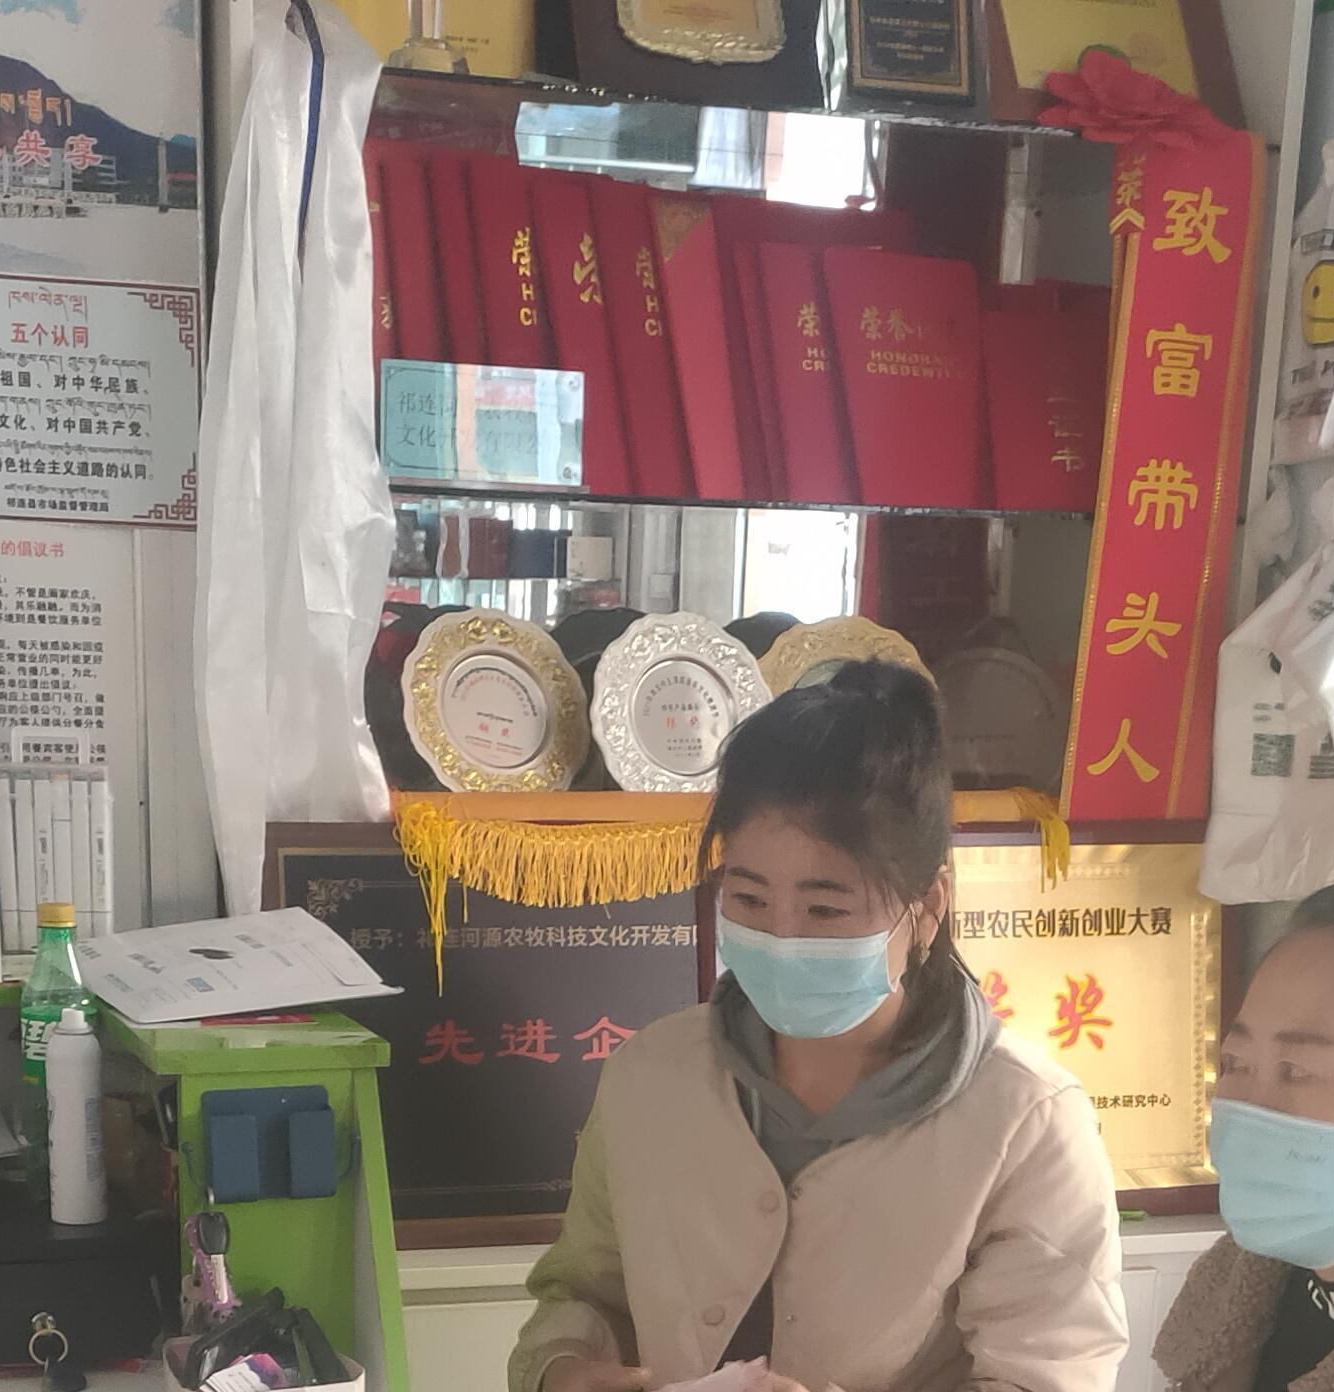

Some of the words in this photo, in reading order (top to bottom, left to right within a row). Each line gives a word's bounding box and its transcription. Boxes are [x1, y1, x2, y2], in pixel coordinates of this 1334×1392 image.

[10, 322, 89, 349] 五个认同
[1086, 186, 1233, 783] 致富带头人
